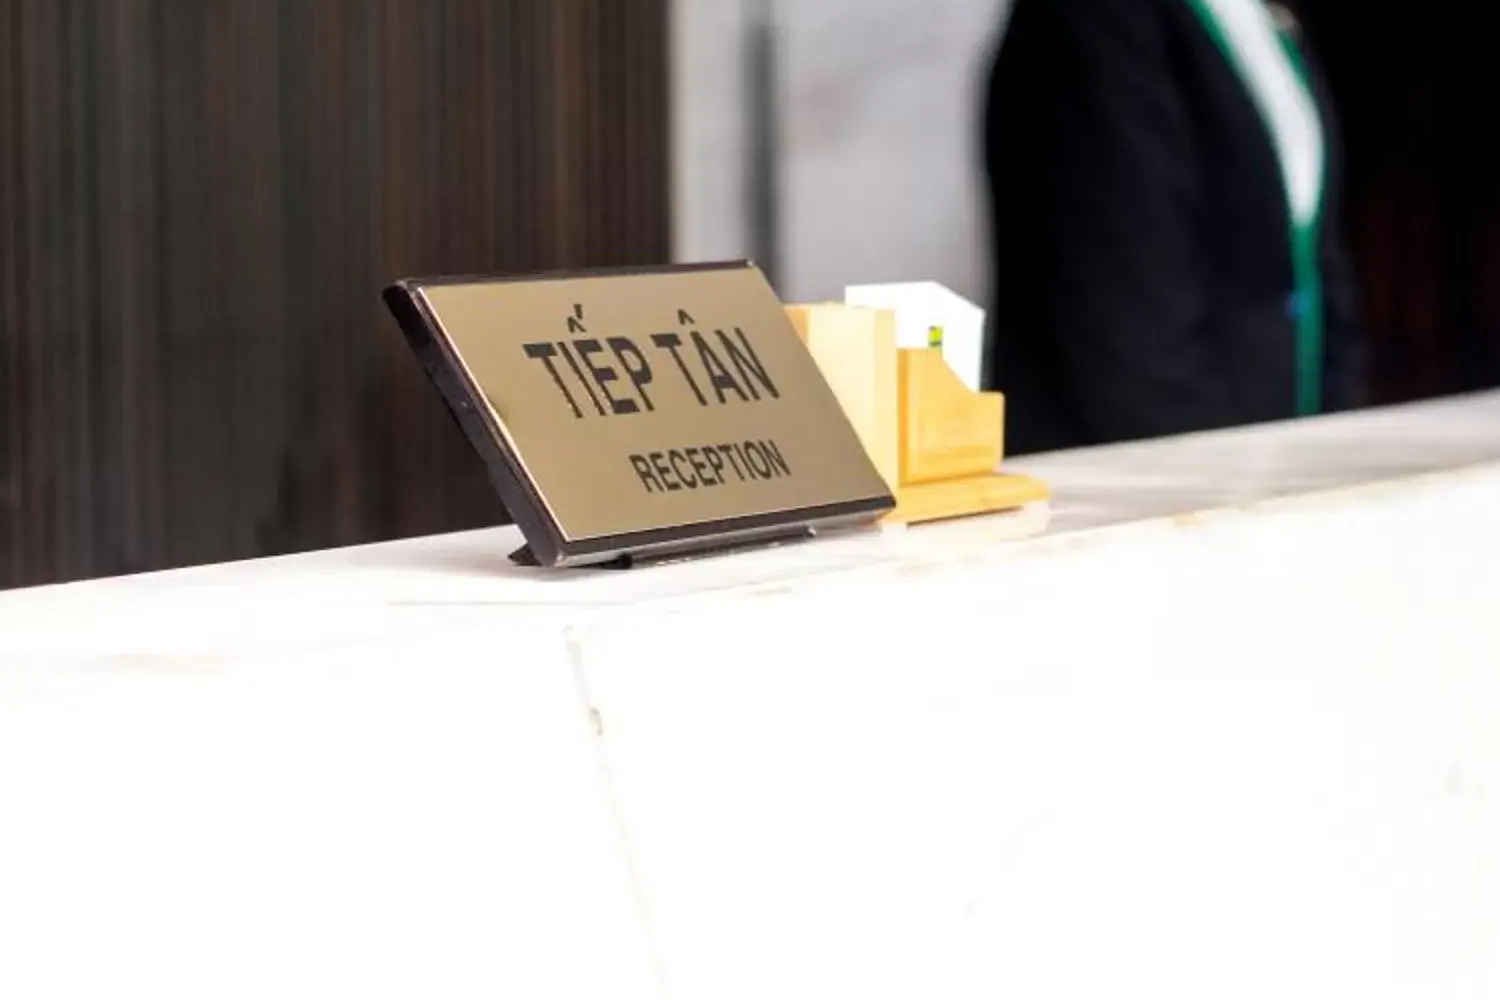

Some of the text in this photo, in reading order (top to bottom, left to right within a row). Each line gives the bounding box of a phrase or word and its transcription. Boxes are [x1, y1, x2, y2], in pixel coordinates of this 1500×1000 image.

[522, 304, 780, 418] TIẾP TÂN
[628, 439, 791, 493] RECEPTION
